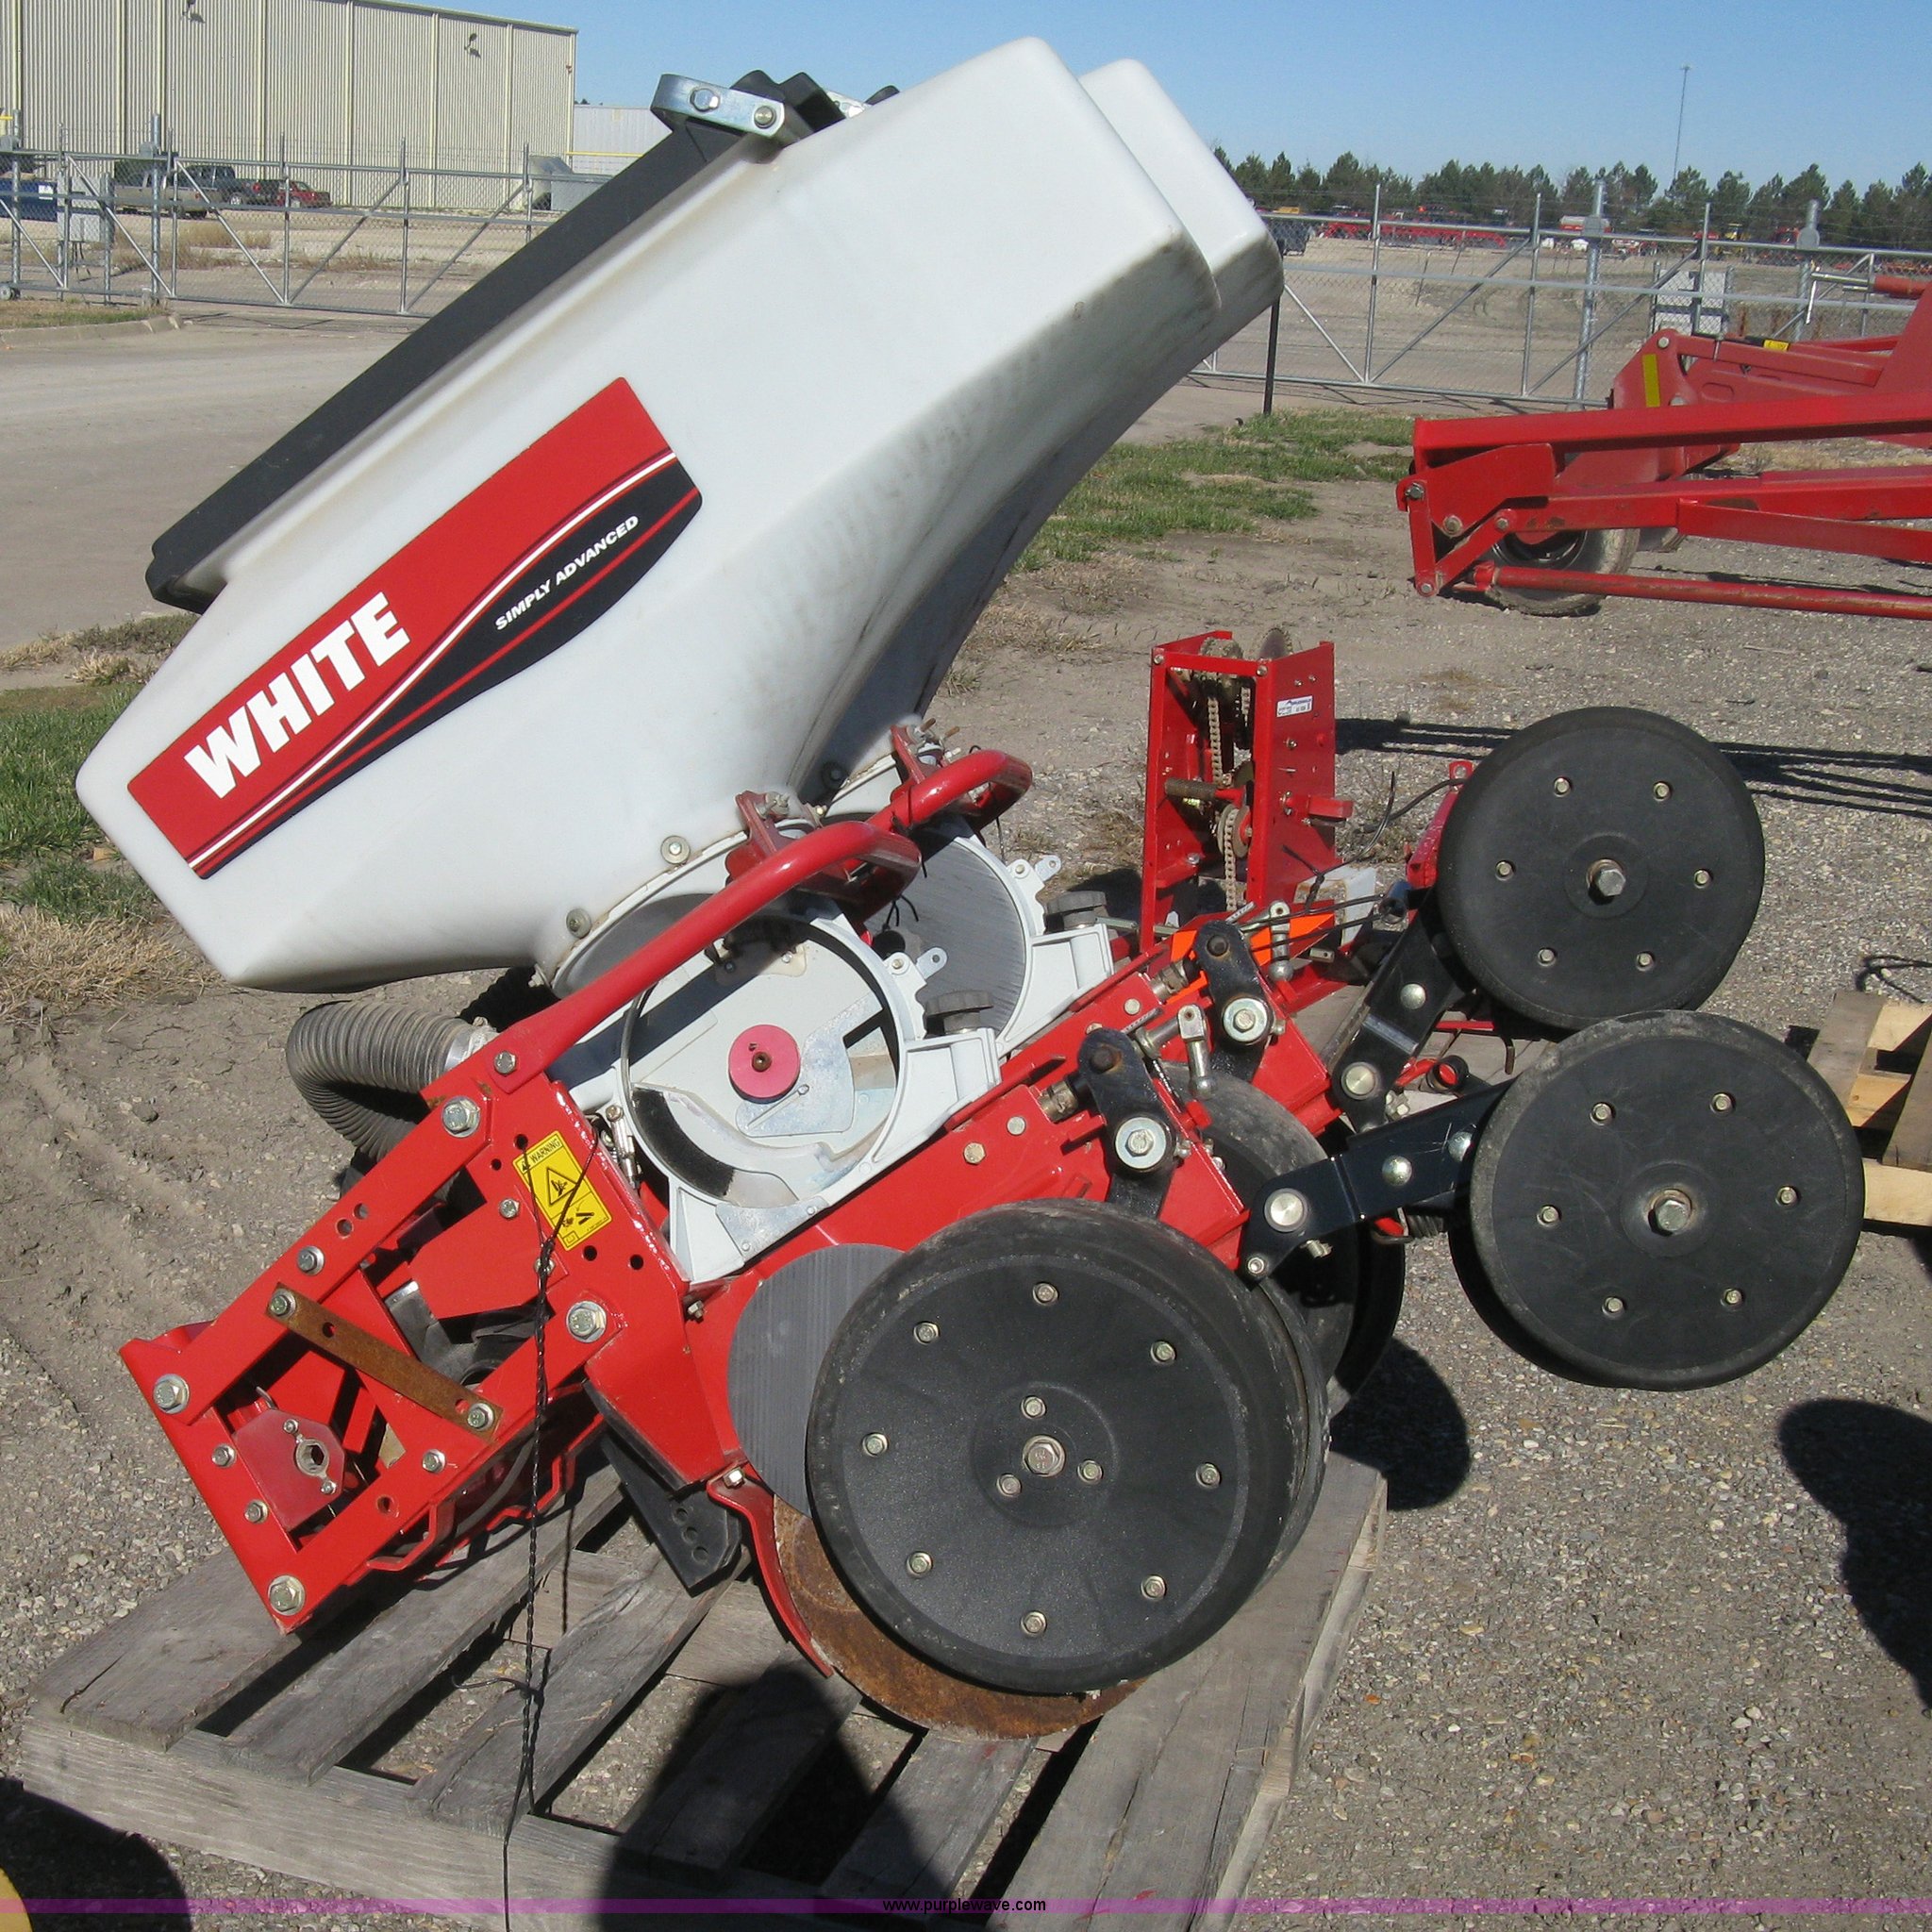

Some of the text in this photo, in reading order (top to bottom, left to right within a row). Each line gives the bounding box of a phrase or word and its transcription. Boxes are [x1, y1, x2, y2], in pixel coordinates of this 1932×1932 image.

[495, 516, 639, 630] SIMPLY ADVANCED
[183, 591, 411, 799] WHITE
[530, 1140, 560, 1163] WARNING
